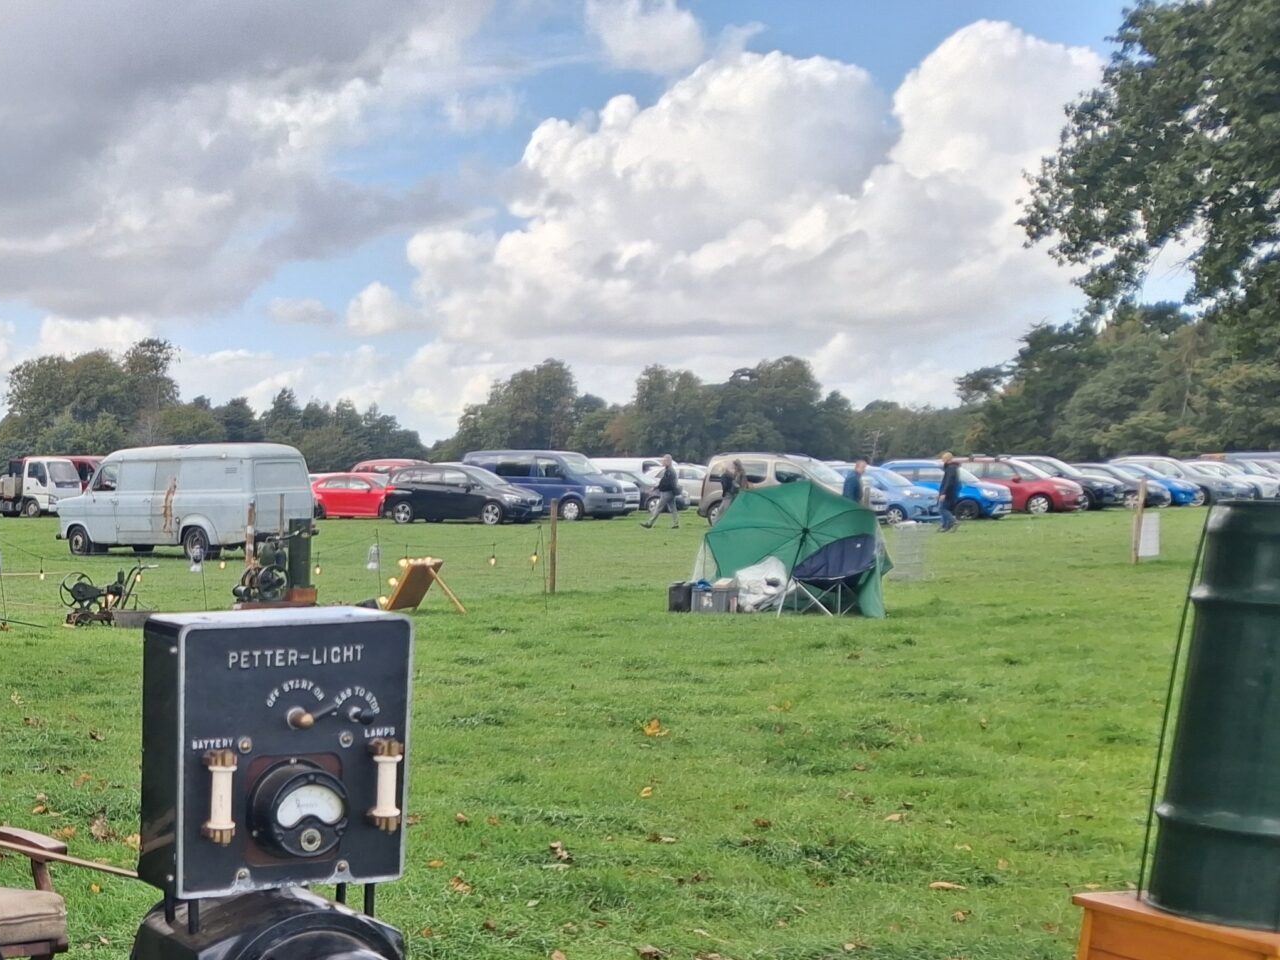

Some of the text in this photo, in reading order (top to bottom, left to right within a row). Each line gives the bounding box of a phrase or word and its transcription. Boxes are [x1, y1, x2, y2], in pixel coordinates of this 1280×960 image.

[228, 645, 363, 669] PETTER-LIGHT
[266, 679, 325, 707] OFF START ON
[354, 686, 365, 697] TO
[365, 691, 380, 714] STOP
[192, 738, 233, 750] BATTERY
[364, 727, 395, 738] LAMPS
